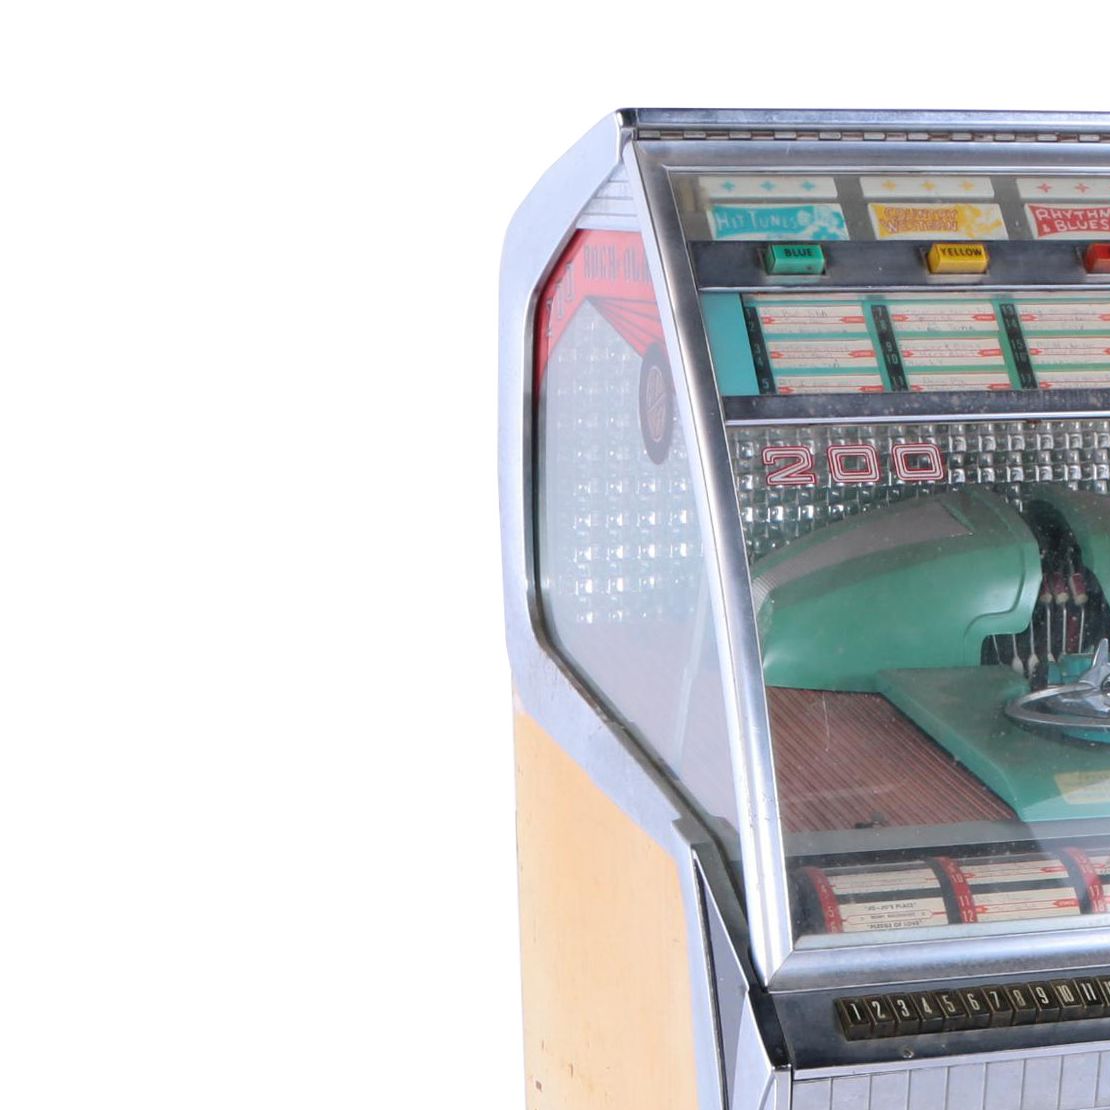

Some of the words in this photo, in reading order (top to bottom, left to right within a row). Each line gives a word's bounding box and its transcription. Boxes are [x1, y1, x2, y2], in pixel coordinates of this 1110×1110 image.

[1056, 219, 1110, 232] BLUES
[783, 248, 813, 257] BLUE
[939, 247, 983, 257] YELLOW
[762, 443, 945, 486] 200
[851, 1003, 861, 1021] 1
[872, 1001, 886, 1018] 2
[897, 999, 909, 1017] 3
[921, 997, 932, 1014] 4
[944, 994, 955, 1012] 5
[967, 993, 980, 1010] 6
[989, 991, 1000, 1008] 7
[1013, 989, 1026, 1006] 8
[1036, 987, 1049, 1004] 9
[1056, 985, 1073, 1002] 10
[1081, 983, 1097, 1000] 11
